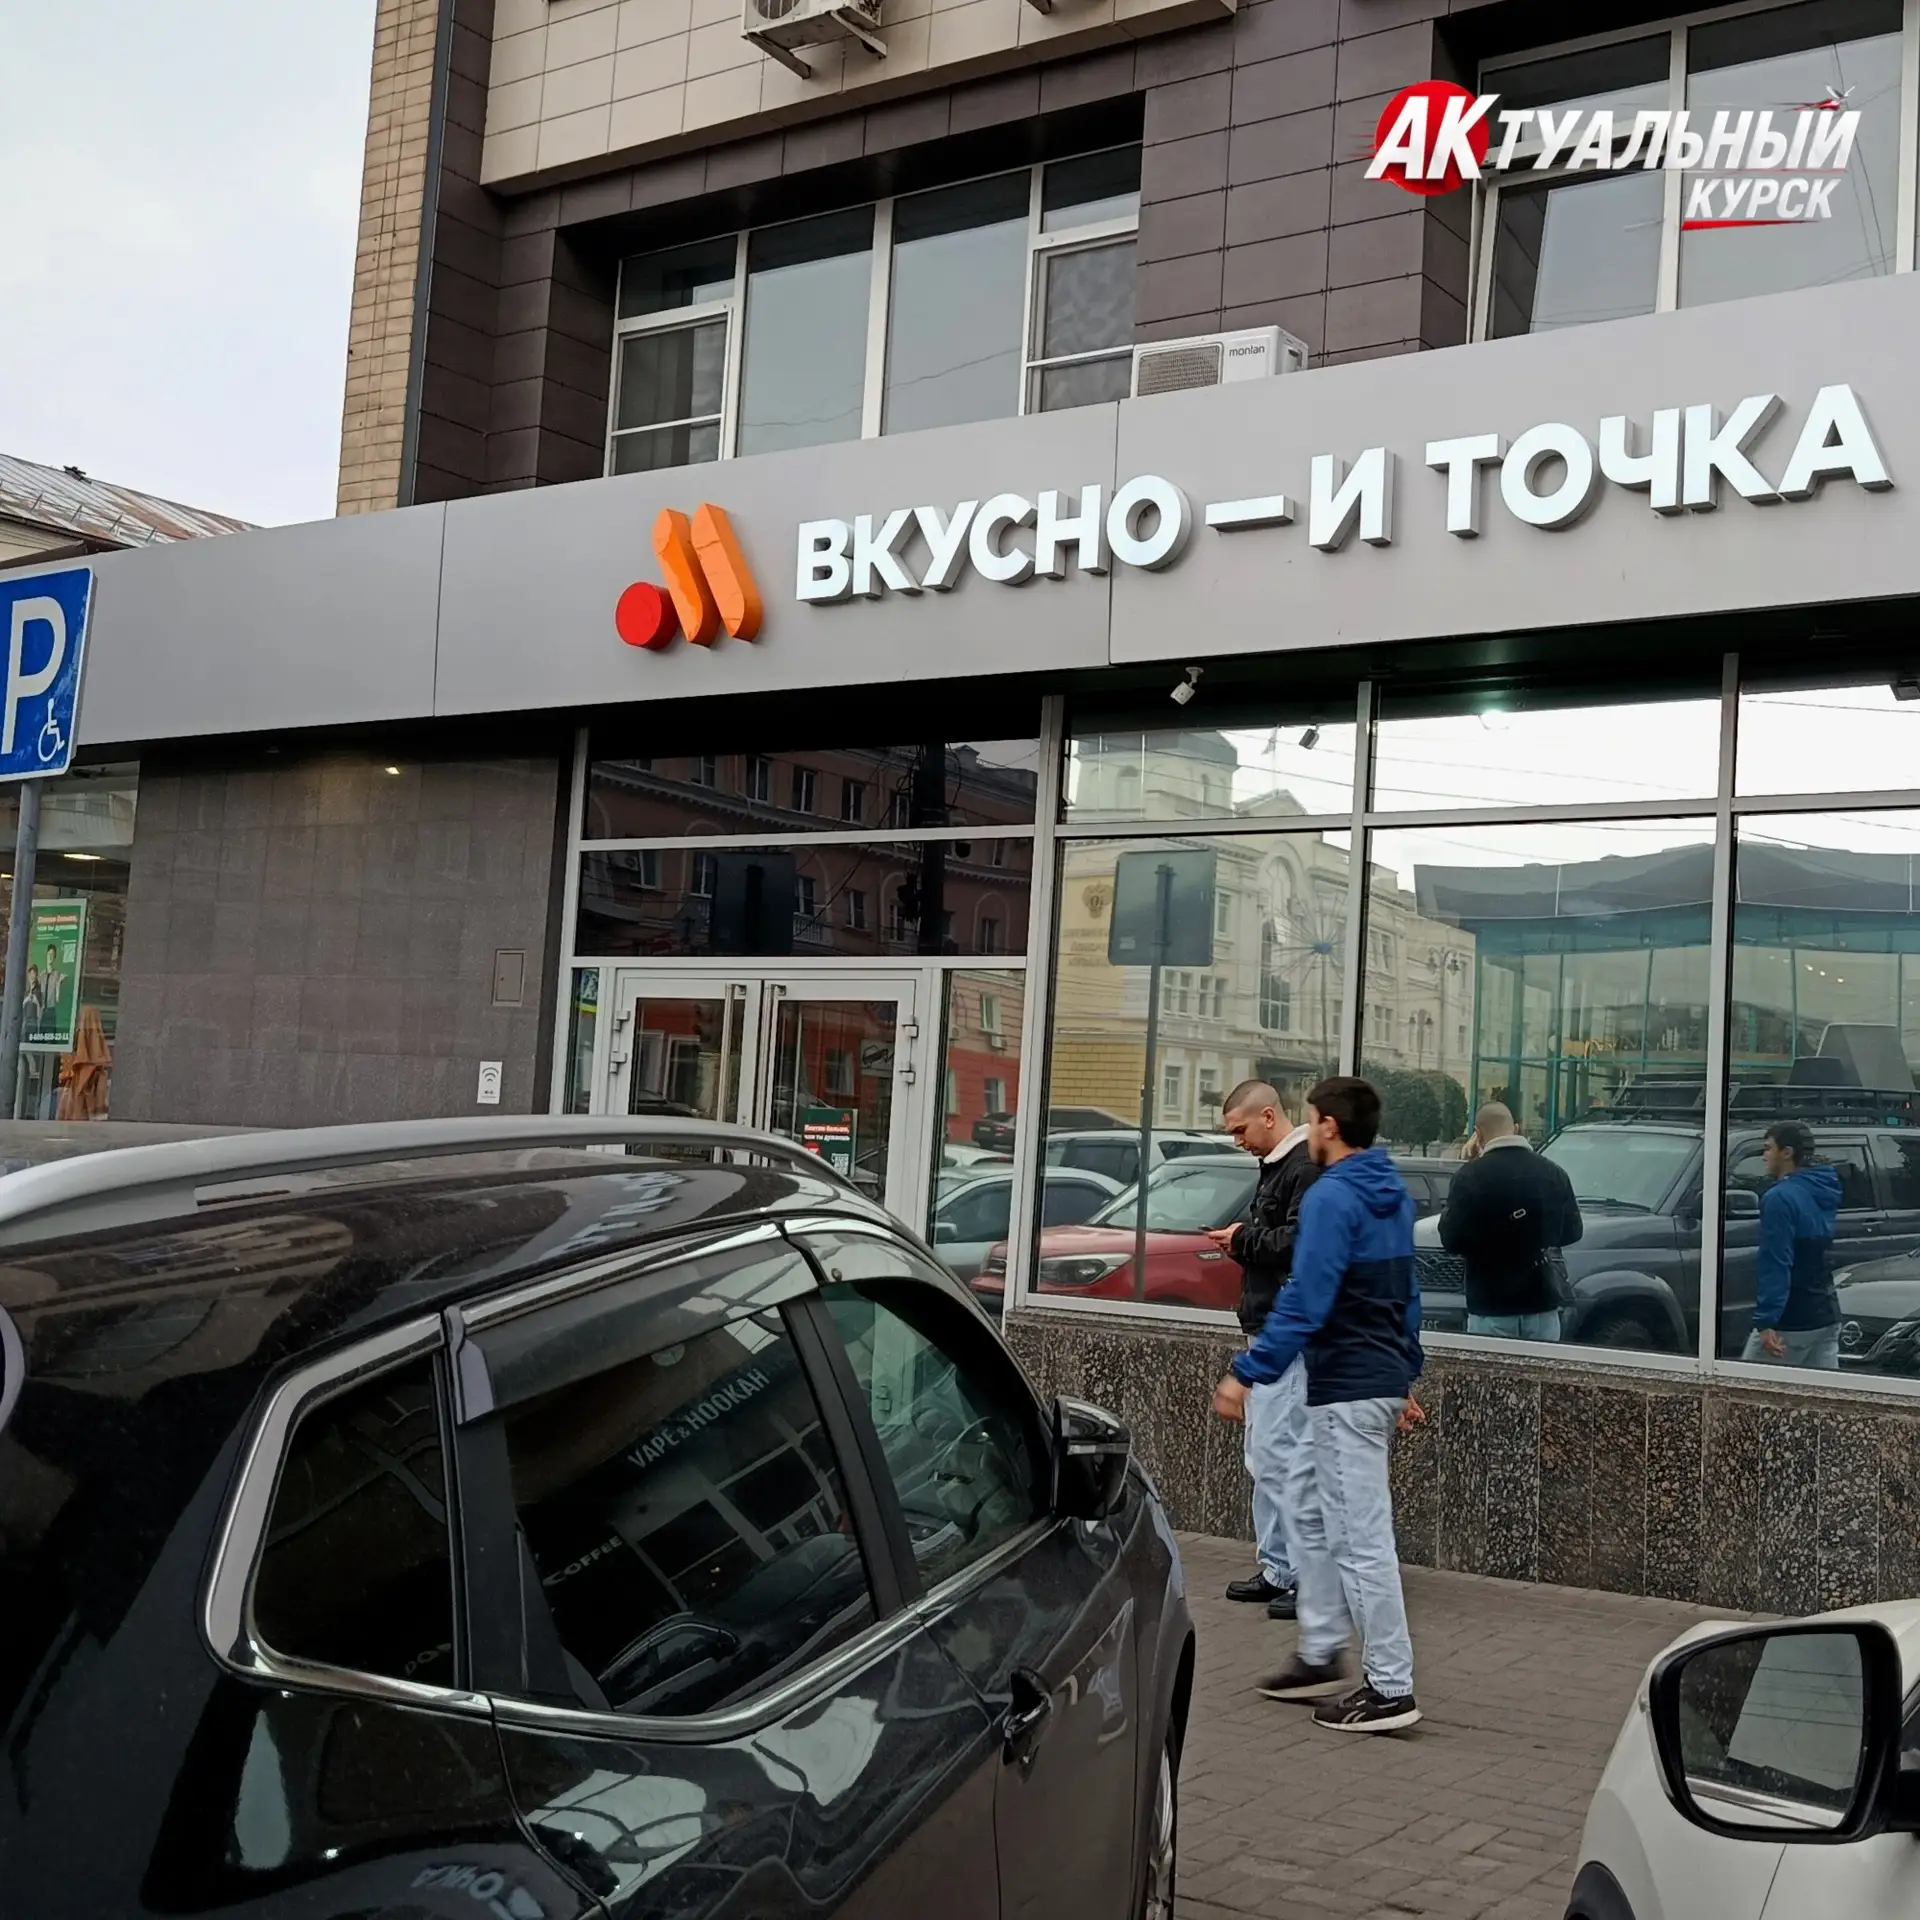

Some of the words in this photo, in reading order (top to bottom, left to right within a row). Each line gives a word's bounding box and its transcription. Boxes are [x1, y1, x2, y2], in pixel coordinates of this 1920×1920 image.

[1229, 345, 1265, 357] monlan
[796, 474, 1192, 604] ВКУСНО
[1309, 447, 1394, 551] И
[1426, 384, 1894, 538] ТОЧКА
[1, 596, 66, 755] P
[628, 1427, 680, 1469] VAPE
[676, 1426, 691, 1439] &
[685, 1367, 770, 1431] HOOKAH
